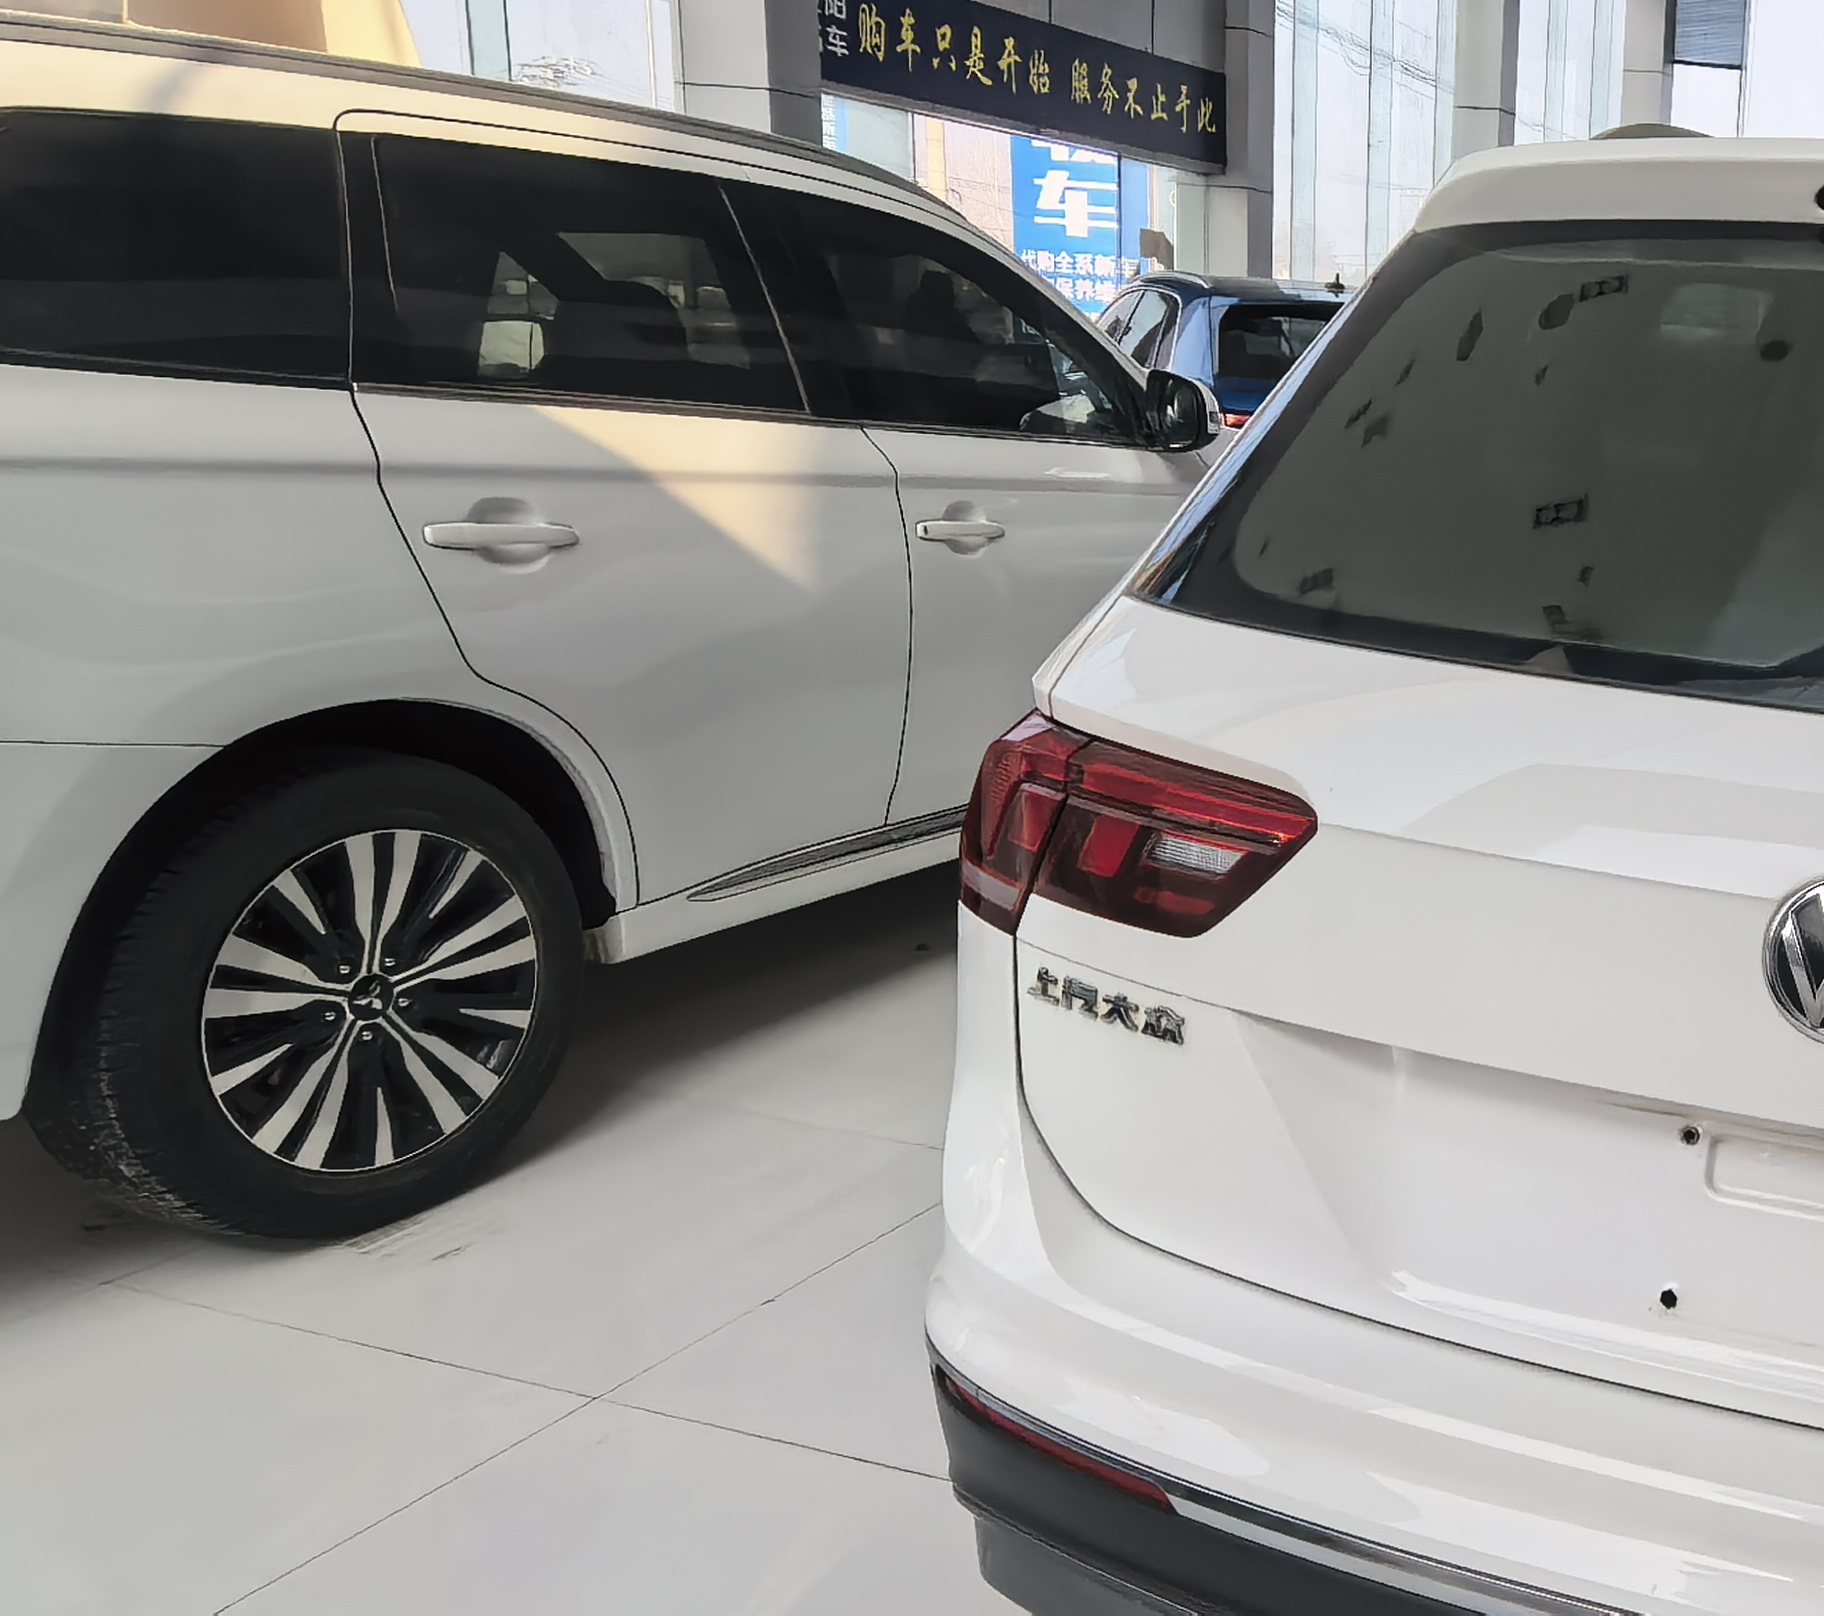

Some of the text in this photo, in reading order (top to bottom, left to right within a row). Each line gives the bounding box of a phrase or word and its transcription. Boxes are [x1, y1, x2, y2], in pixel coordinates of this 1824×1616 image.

[858, 3, 1216, 133] 购车只是开始 服务不止于此
[1027, 966, 1186, 1045] 上汽大众
